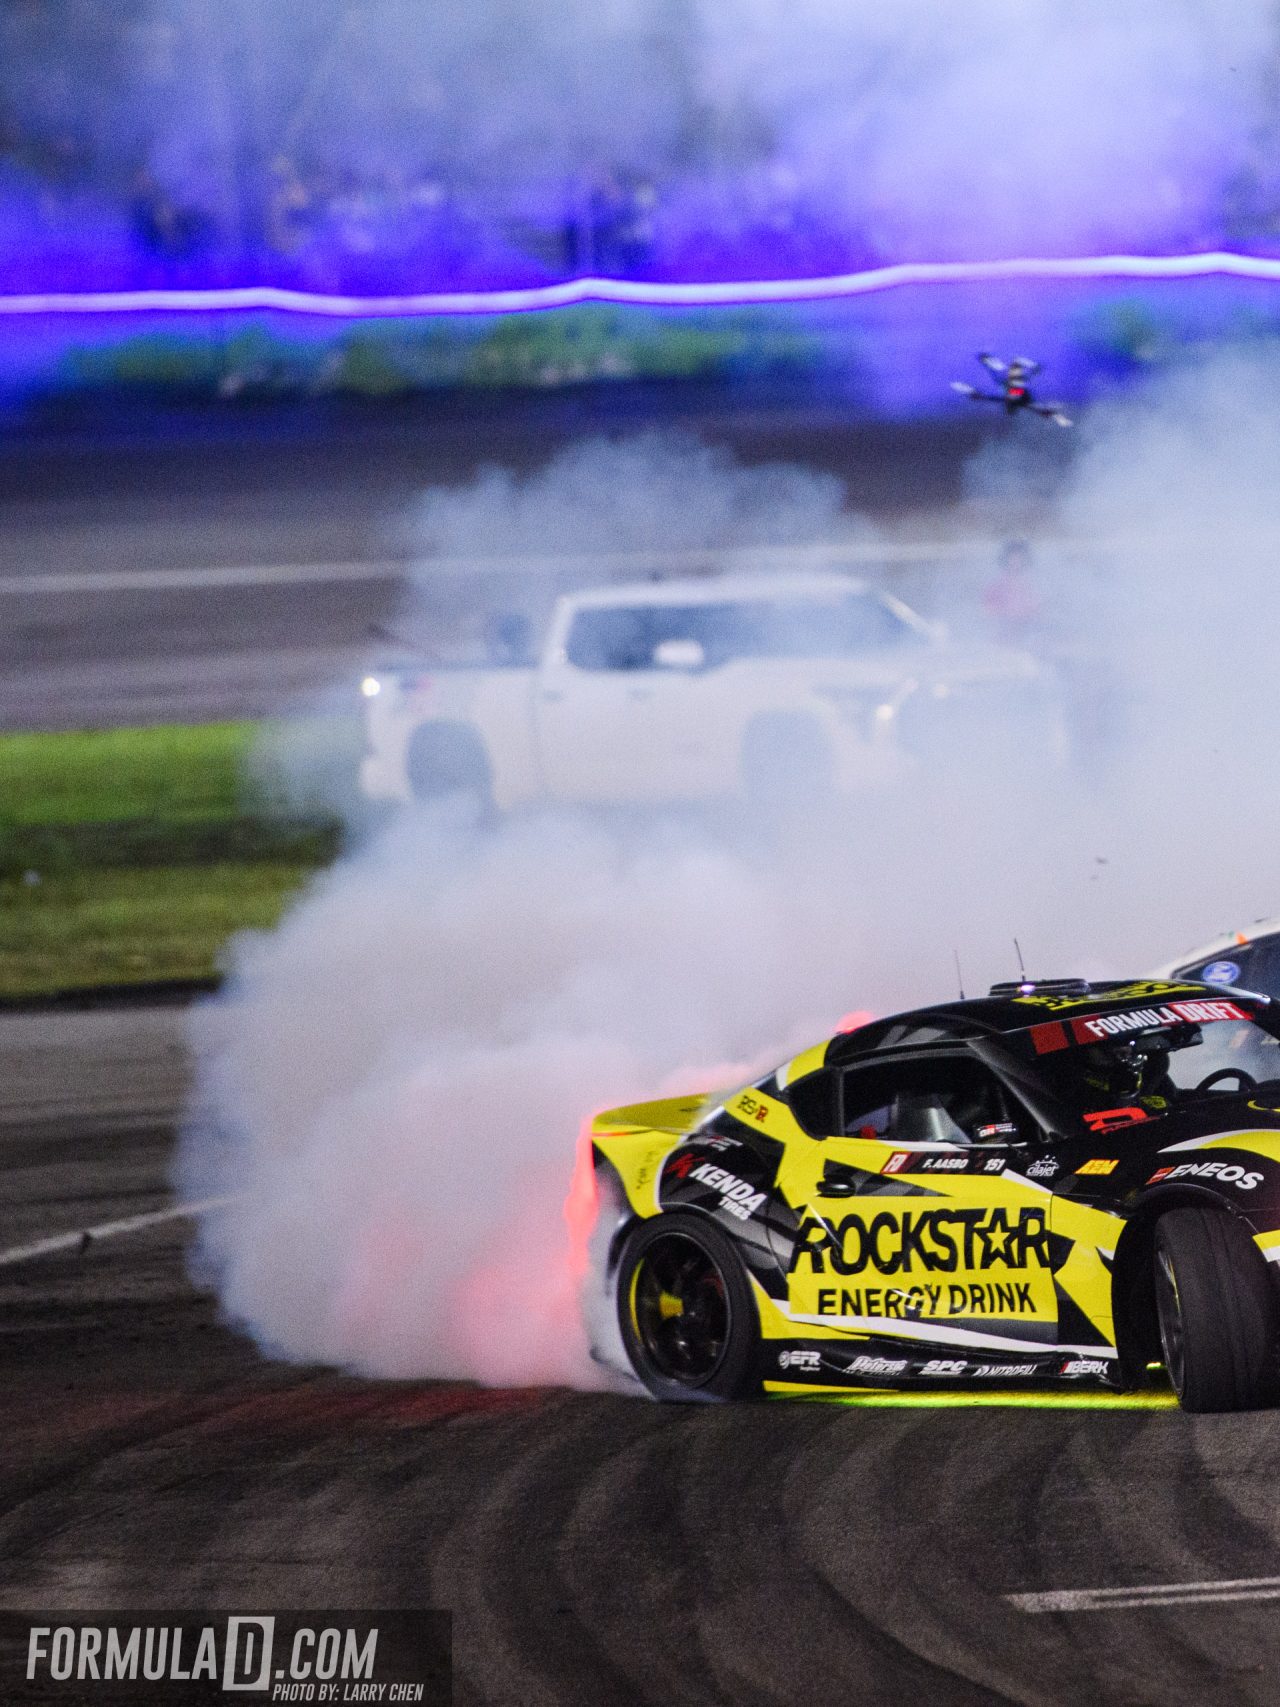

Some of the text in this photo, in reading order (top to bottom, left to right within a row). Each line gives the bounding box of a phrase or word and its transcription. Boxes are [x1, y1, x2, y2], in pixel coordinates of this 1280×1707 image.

[1084, 1001, 1246, 1037] FORMULA DRIFT
[983, 1158, 1006, 1171] 151
[1164, 1162, 1265, 1190] ENEOS
[689, 1163, 768, 1212] KENDA
[718, 1196, 751, 1221] TIRES
[788, 1206, 1052, 1276] ROCKSTAR
[818, 1282, 1038, 1318] ENERGY DRINK
[924, 1360, 968, 1372] SPC
[1073, 1360, 1110, 1374] BERK
